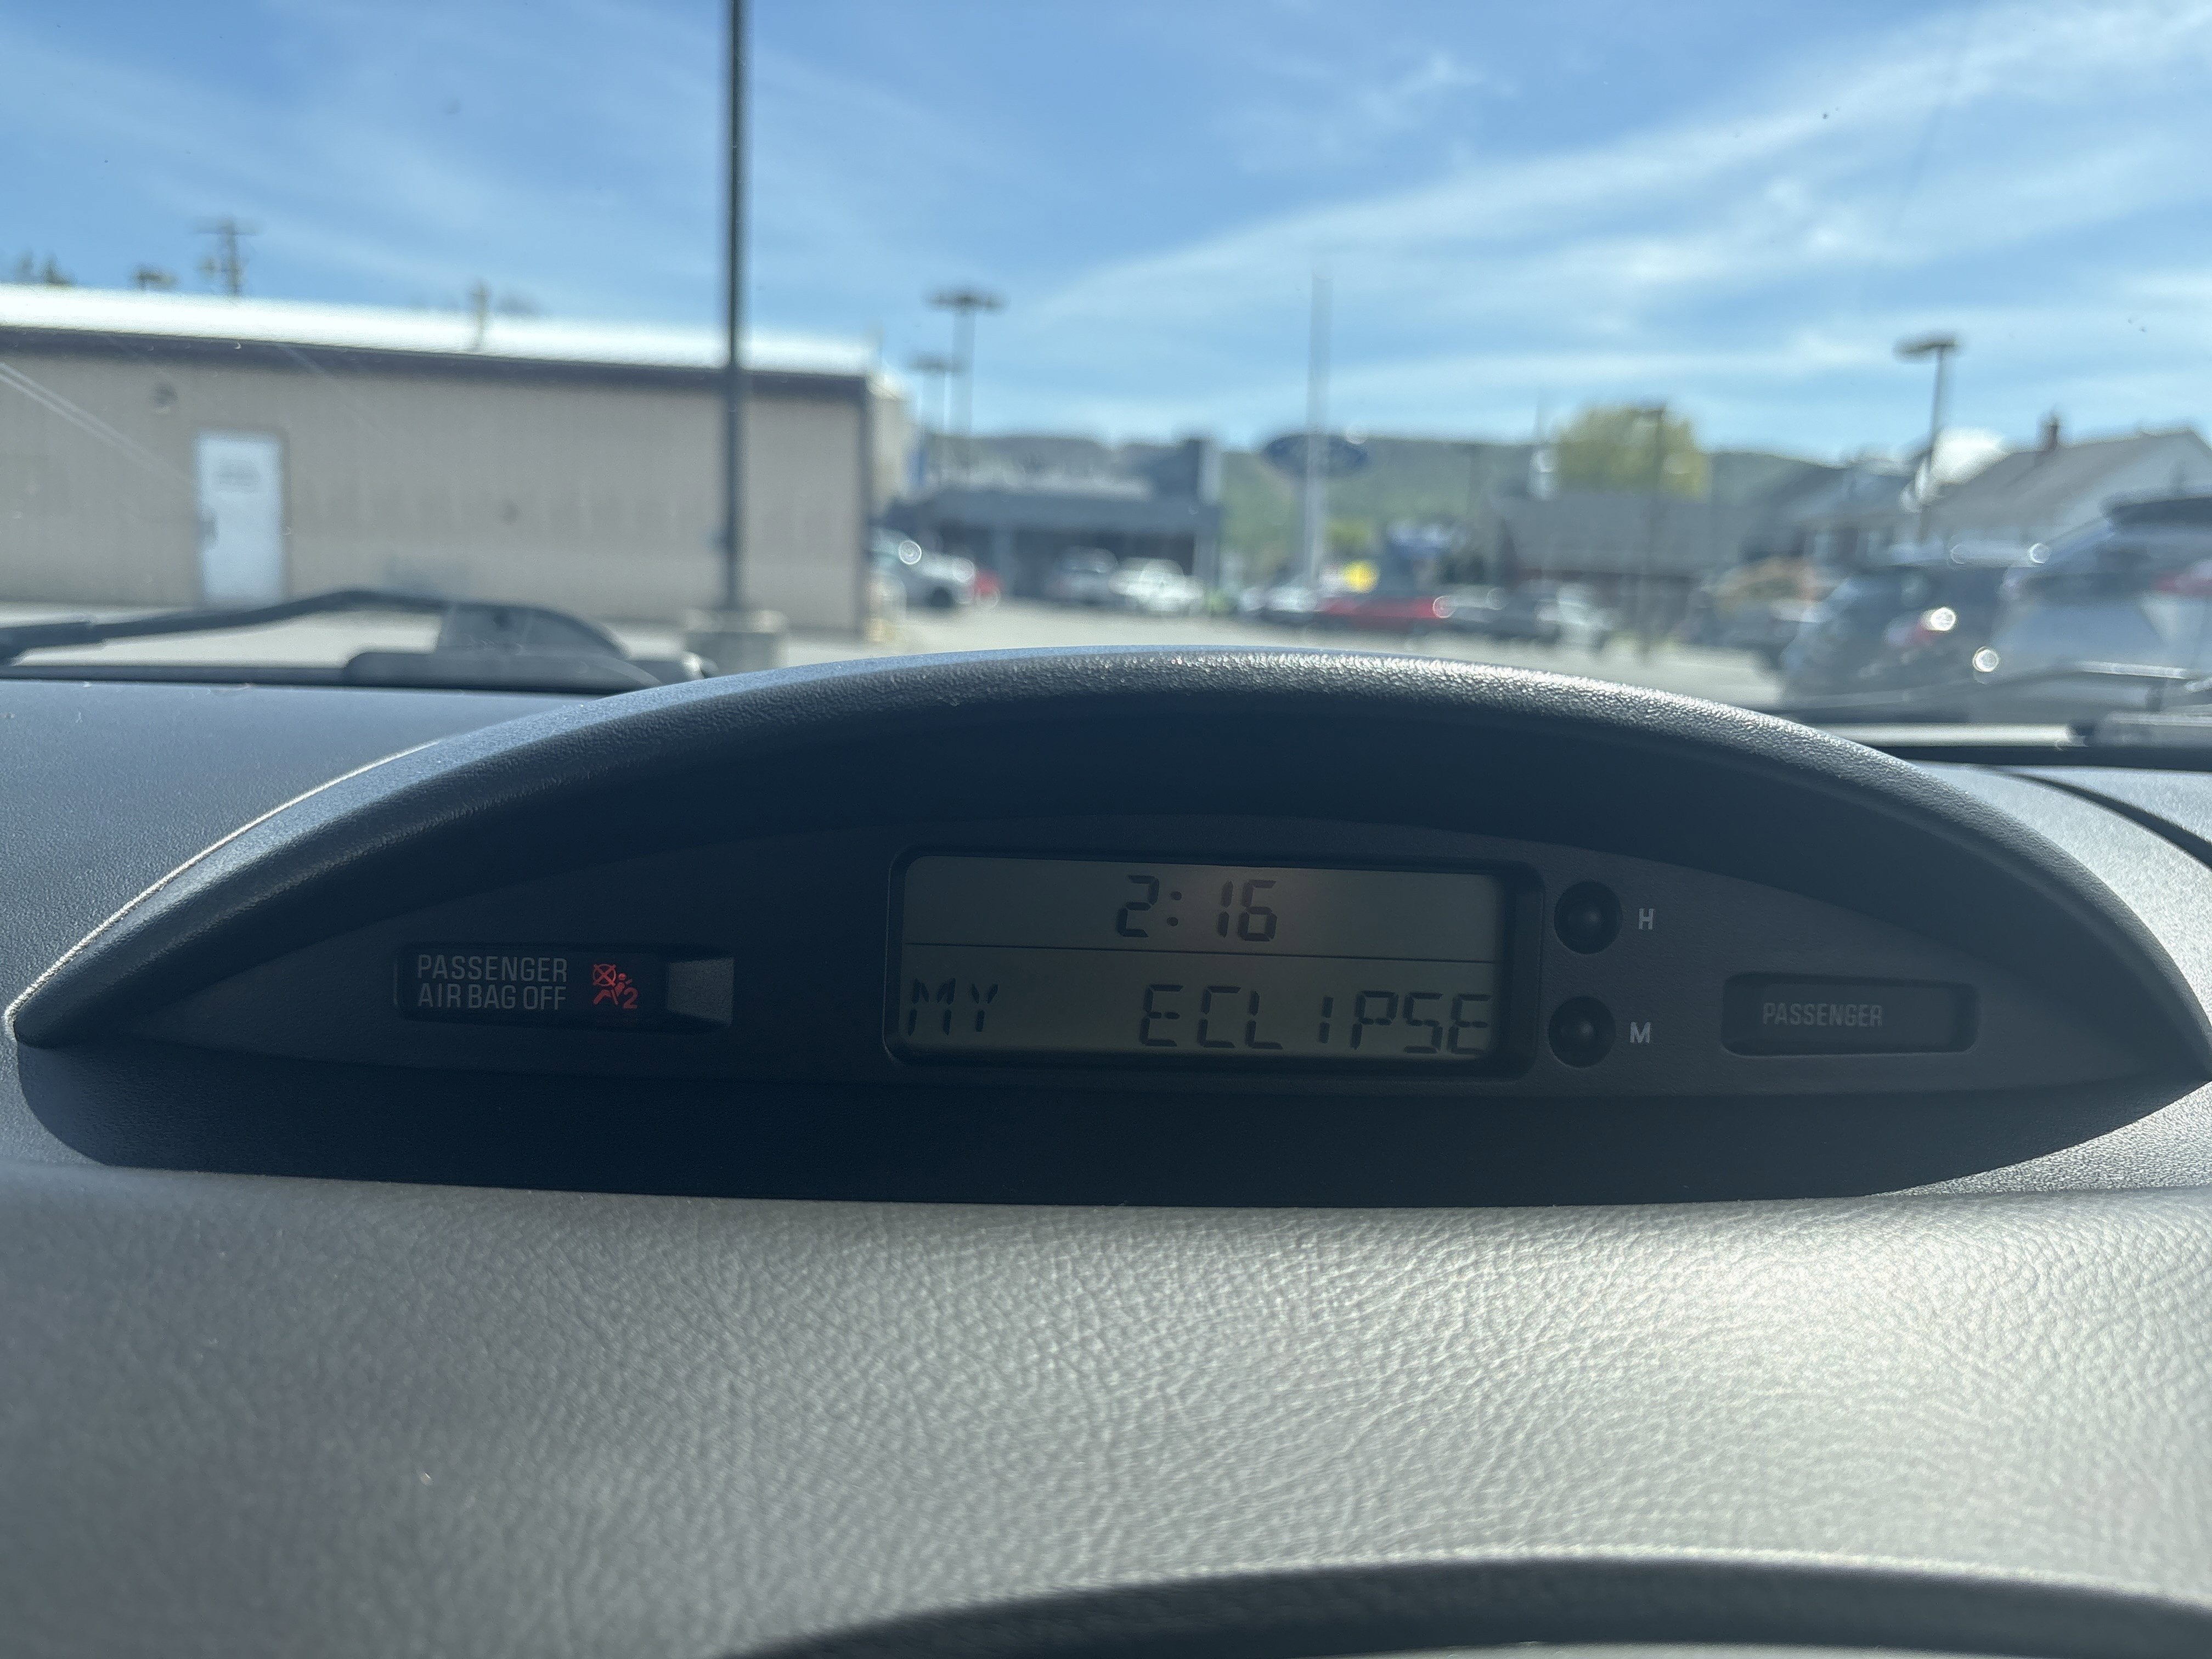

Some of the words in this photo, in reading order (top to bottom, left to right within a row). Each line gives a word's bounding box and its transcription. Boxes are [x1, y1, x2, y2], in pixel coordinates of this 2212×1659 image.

[1116, 875, 1278, 942] 2:16
[1638, 908, 1655, 930] H
[417, 953, 568, 983] PASSENGER
[417, 983, 461, 1008] AIR
[467, 983, 516, 1009] BAG
[523, 985, 567, 1010] OFF
[908, 977, 999, 1036] MY
[1138, 984, 1492, 1055] ECLIPSE
[1762, 1002, 1884, 1028] PASSENGER
[1629, 1022, 1652, 1044] M
